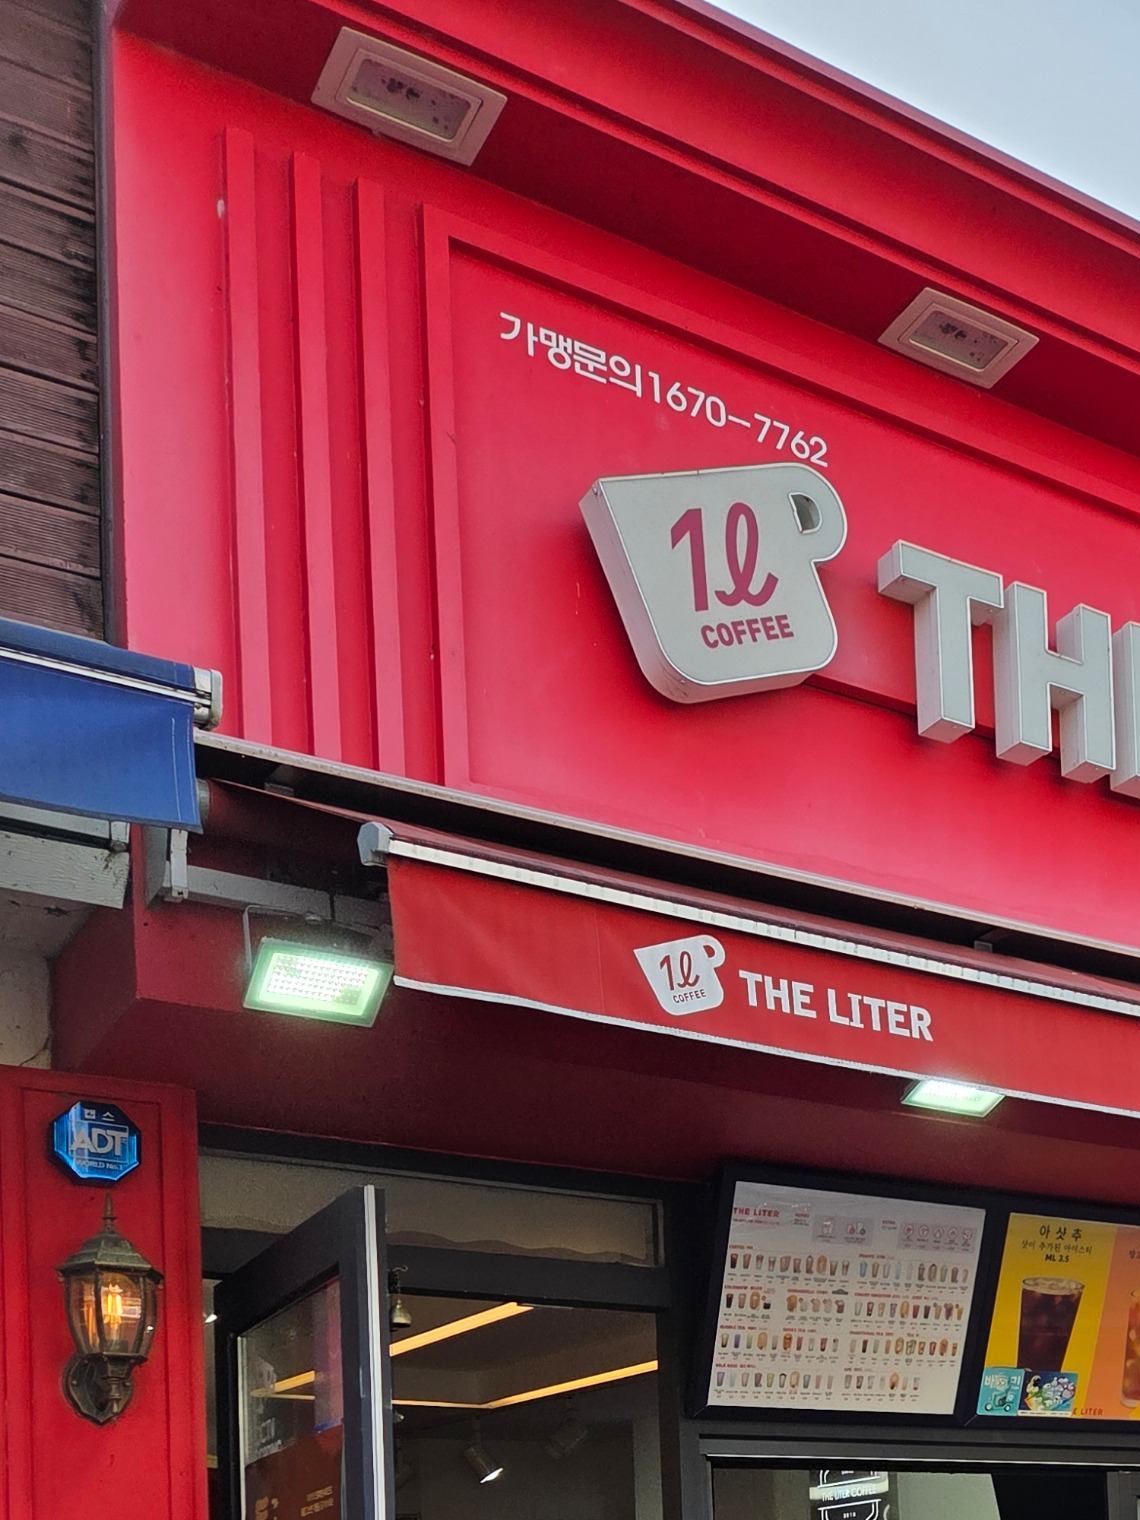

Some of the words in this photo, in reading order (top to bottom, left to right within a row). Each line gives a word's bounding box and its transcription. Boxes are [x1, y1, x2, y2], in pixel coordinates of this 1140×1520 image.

[500, 312, 642, 398] 가맹문의
[647, 371, 829, 467] 1670-7762
[701, 614, 794, 649] COFFEE
[673, 988, 706, 1004] COFFEE
[739, 970, 816, 1018] THE
[827, 988, 933, 1041] LITER
[71, 1128, 124, 1156] ADT
[734, 1207, 751, 1215] THE
[754, 1209, 780, 1218] LITER
[1045, 1254, 1057, 1262] ML
[1080, 1407, 1104, 1416] LITER
